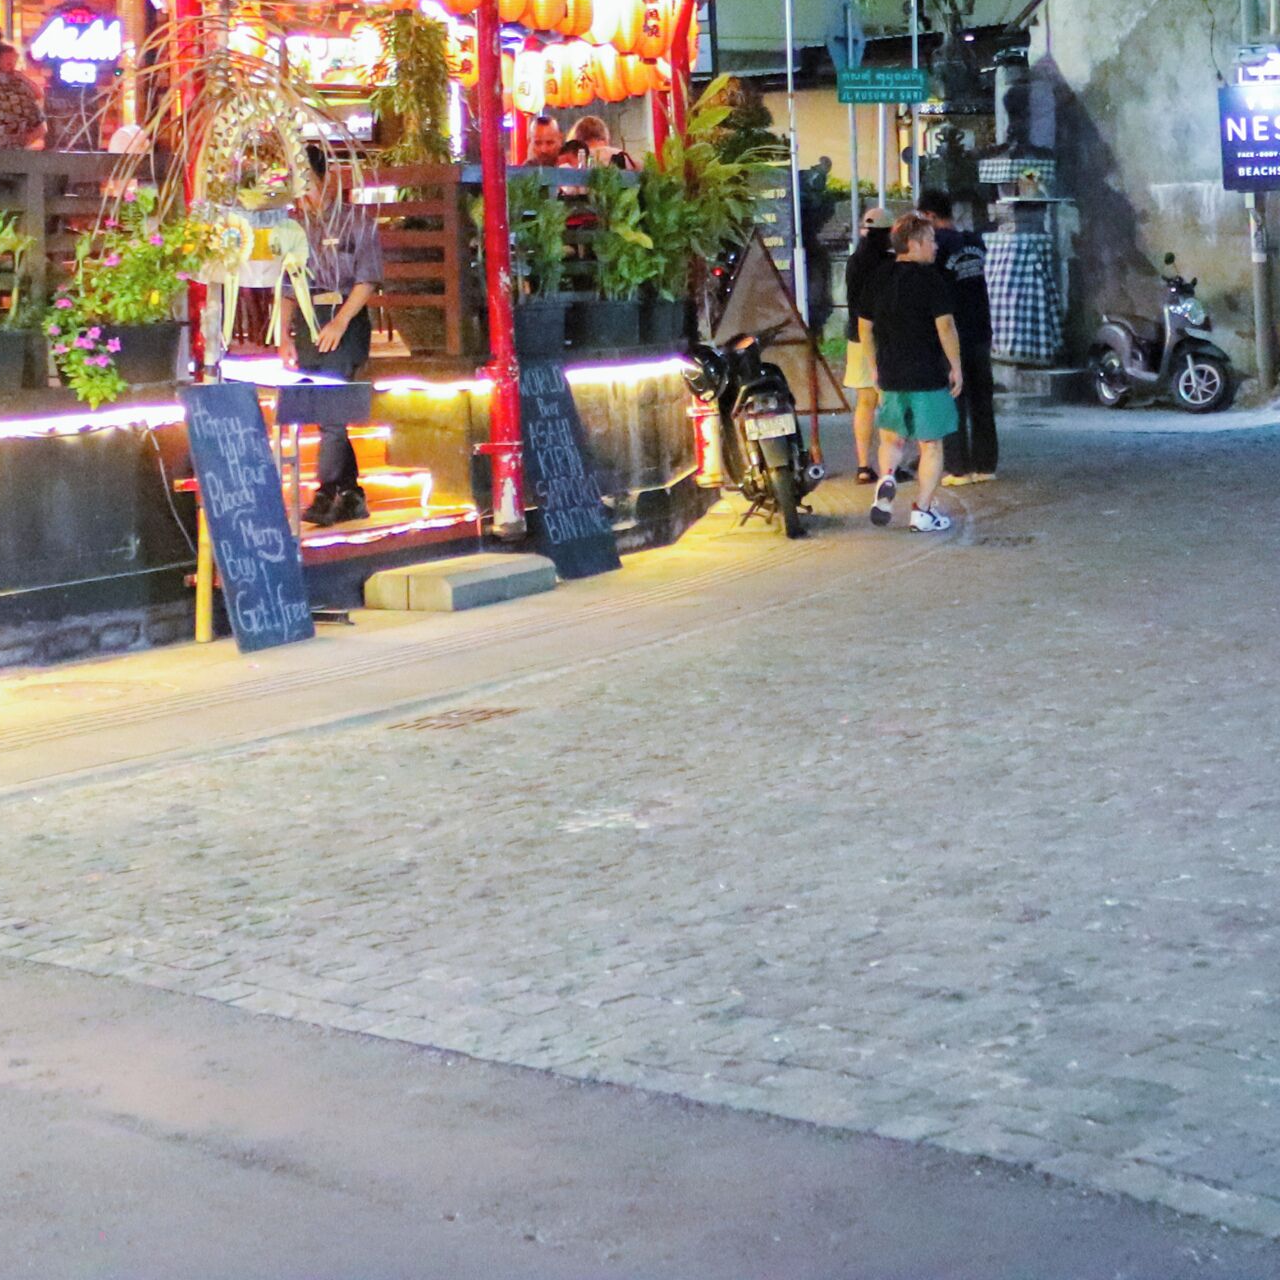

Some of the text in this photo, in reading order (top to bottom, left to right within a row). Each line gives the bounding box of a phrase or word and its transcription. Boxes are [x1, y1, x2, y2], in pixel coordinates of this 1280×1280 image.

[520, 366, 565, 396] WORLD
[529, 419, 574, 450] ASAHI
[537, 446, 584, 480] KIRIN
[536, 472, 602, 511] SAPPORO
[221, 540, 257, 584] Buy
[236, 591, 266, 635] Get
[277, 584, 308, 641] free
